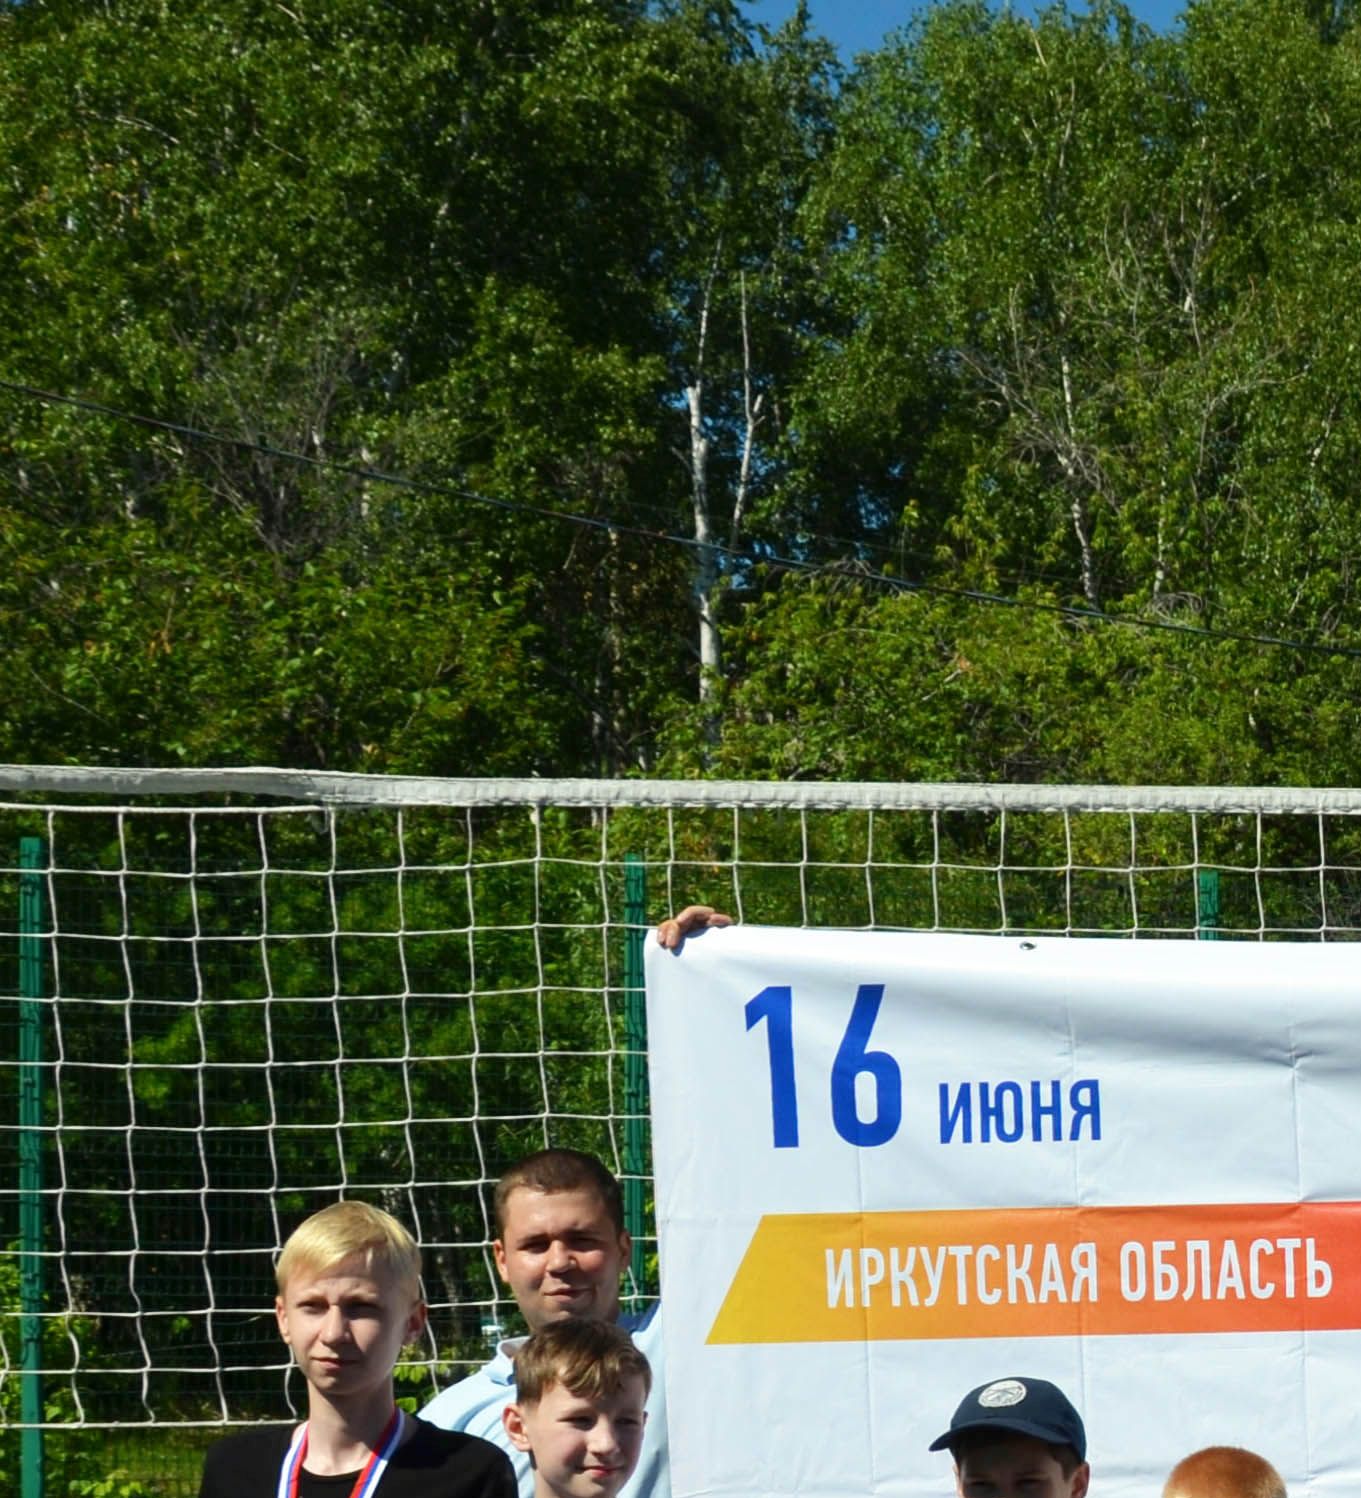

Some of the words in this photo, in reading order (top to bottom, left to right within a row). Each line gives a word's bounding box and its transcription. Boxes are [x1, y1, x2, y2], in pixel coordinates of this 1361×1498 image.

[744, 983, 903, 1149] 16
[938, 1079, 1102, 1145] ИЮНЯ
[825, 1241, 1099, 1310] ИРКУТСКАЯ
[1120, 1236, 1334, 1302] ОБЛАСТЬ
